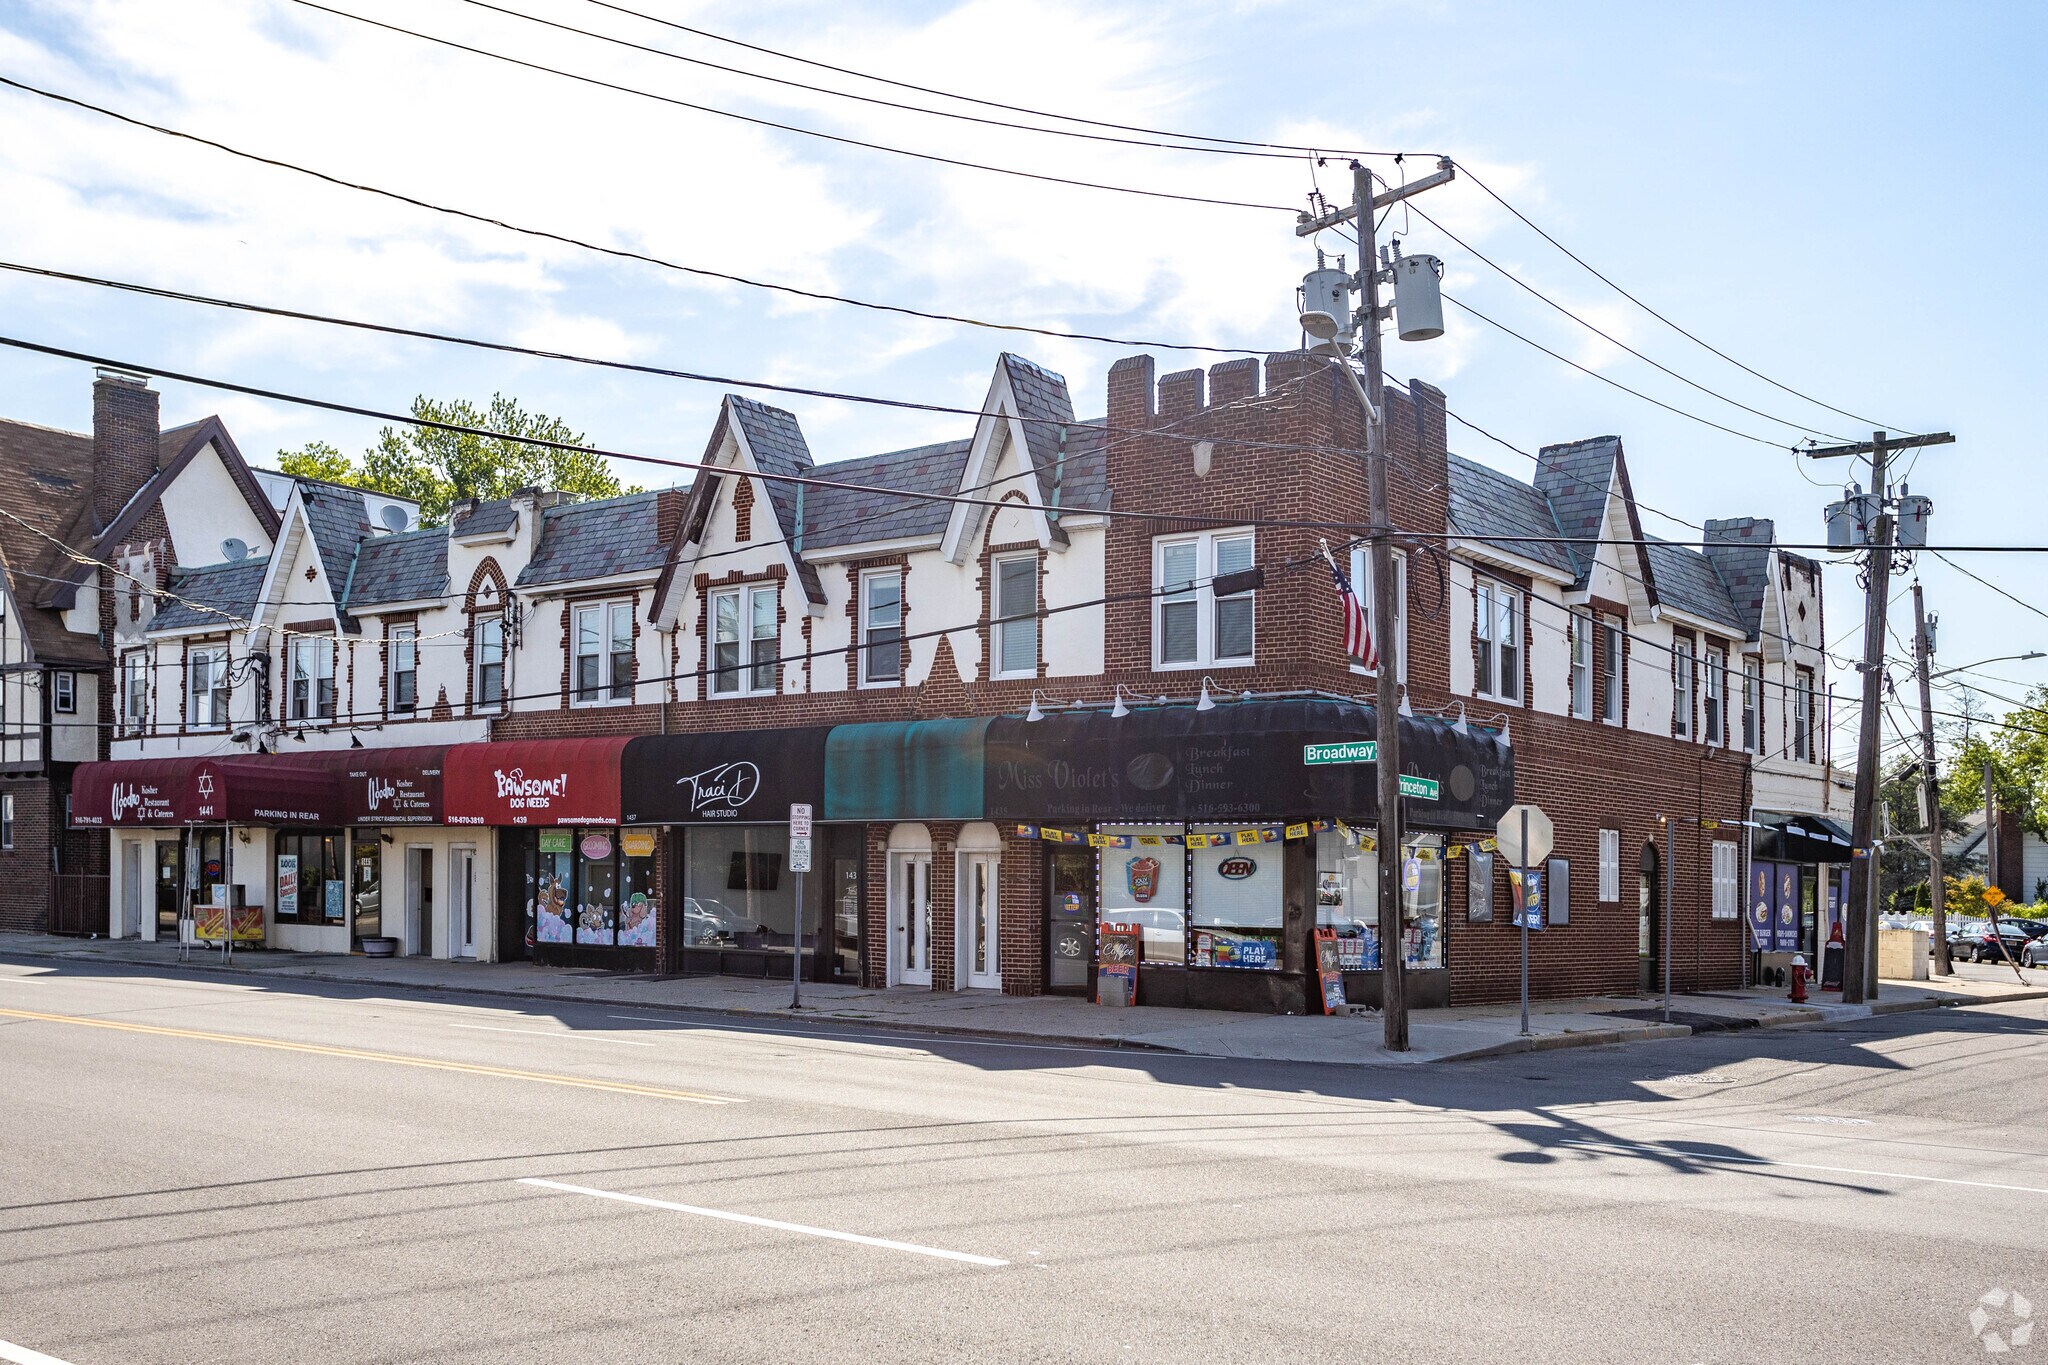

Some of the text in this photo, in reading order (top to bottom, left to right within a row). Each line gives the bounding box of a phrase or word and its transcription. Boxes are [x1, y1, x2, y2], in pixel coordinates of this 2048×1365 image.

[1185, 747, 1251, 761] Breakfast
[1307, 745, 1374, 760] Broadway
[998, 760, 1119, 789] Miss Violet's
[1185, 762, 1223, 777] Lunch
[1480, 765, 1511, 780] Breakfast
[494, 769, 567, 797] PAWSOME!
[676, 761, 760, 812] Traci D
[1185, 778, 1233, 793] Dinner
[141, 785, 158, 794] Kosher
[400, 790, 425, 798] Restaurant
[1429, 787, 1438, 797] Ave
[144, 798, 169, 807] Restaurant
[410, 800, 429, 808] Caterers
[510, 797, 549, 808] DOG NEEDS
[198, 806, 214, 816] 1441
[1047, 803, 1080, 815] Parking
[1092, 804, 1111, 813] Rear
[1120, 803, 1134, 813] We
[1135, 803, 1165, 813] deliver
[1198, 803, 1261, 813] 516-593-6300
[147, 809, 174, 818] & Caterers
[254, 809, 288, 819] PARKING
[299, 812, 320, 820] REAR
[702, 809, 738, 818] HAIR STUDIO
[448, 816, 484, 824] 516-870-3810
[512, 816, 527, 824] 1439
[557, 816, 617, 825] pawsomedogneeds.com
[541, 838, 566, 848] DAY CARE
[280, 858, 296, 868] LOOK
[1221, 861, 1252, 876] OPEN
[280, 872, 297, 888] DAILY
[1103, 943, 1135, 961] Coffee
[1243, 946, 1266, 955] PLAY
[1242, 954, 1270, 964] HERE.
[1320, 950, 1338, 969] Coffee
[1107, 964, 1130, 975] BEER
